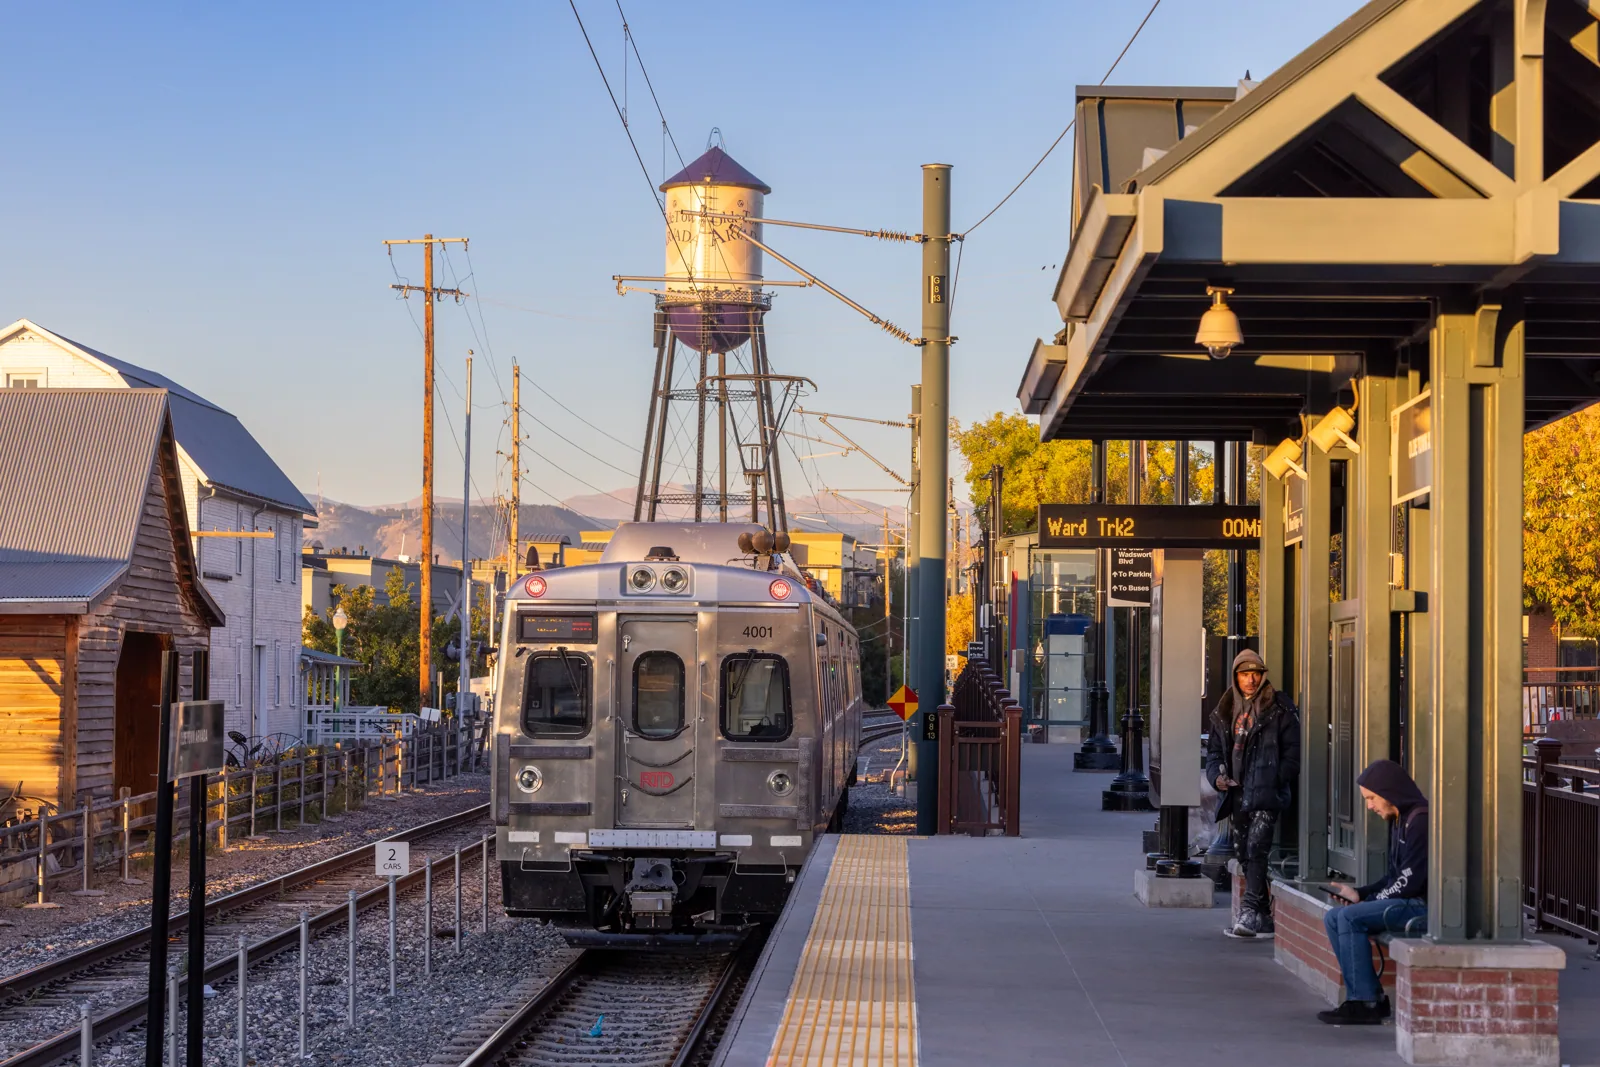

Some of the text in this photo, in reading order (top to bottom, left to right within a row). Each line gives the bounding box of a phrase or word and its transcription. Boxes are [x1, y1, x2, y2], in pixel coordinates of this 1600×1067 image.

[933, 276, 940, 284] G
[934, 285, 940, 293] 8
[933, 294, 941, 302] 13
[1047, 517, 1087, 536] Ward
[1097, 517, 1135, 537] Trk2
[1235, 603, 1242, 612] 11
[742, 626, 773, 638] 4001
[640, 771, 675, 788] RTD
[388, 848, 396, 861] 2
[382, 862, 402, 870] CARS
